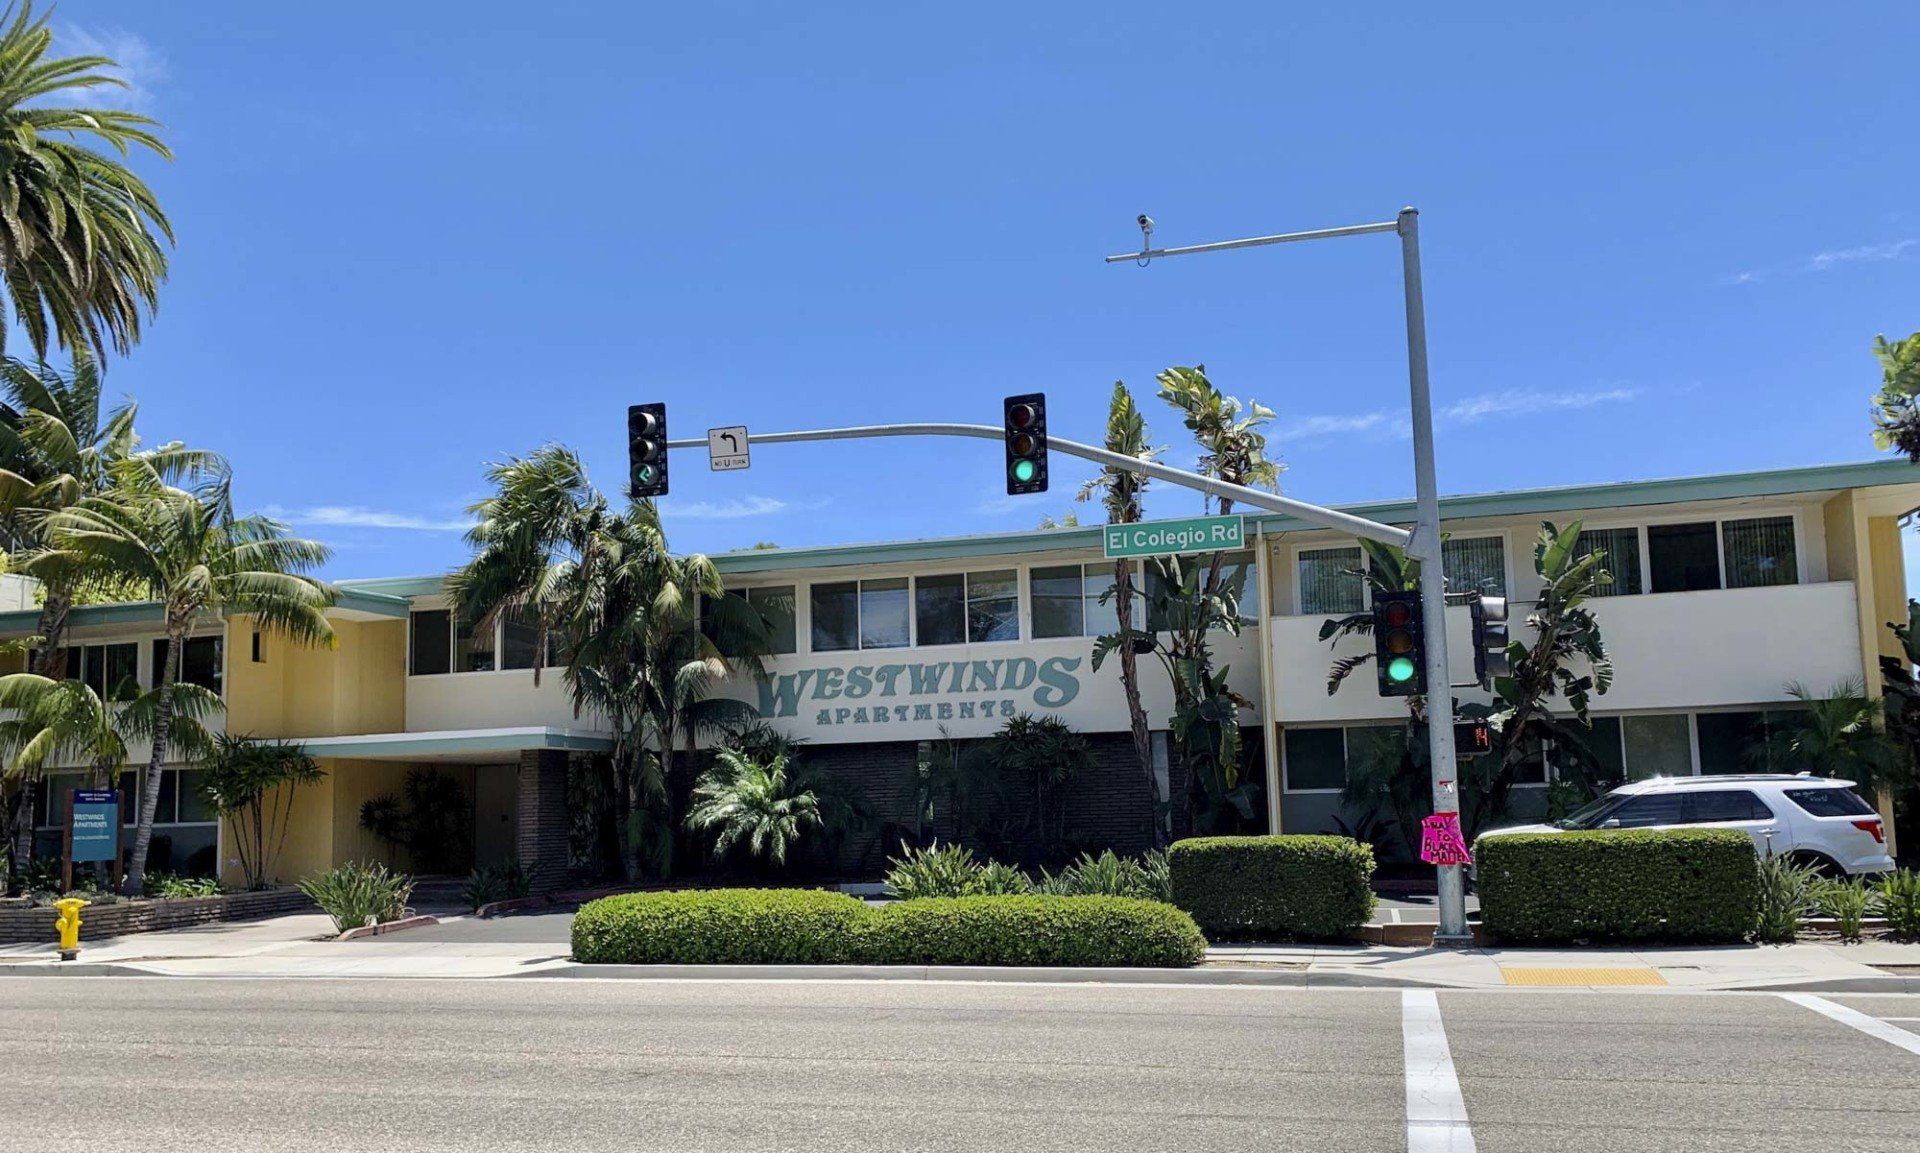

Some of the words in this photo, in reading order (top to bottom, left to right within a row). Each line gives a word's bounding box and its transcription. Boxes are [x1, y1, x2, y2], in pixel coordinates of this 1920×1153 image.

[724, 459, 730, 467] U
[1109, 532, 1127, 549] El
[1133, 527, 1206, 550] Colegio
[1212, 524, 1238, 542] Rd
[757, 656, 1082, 719] WESTWINDS
[816, 699, 1016, 726] APARTMENTS
